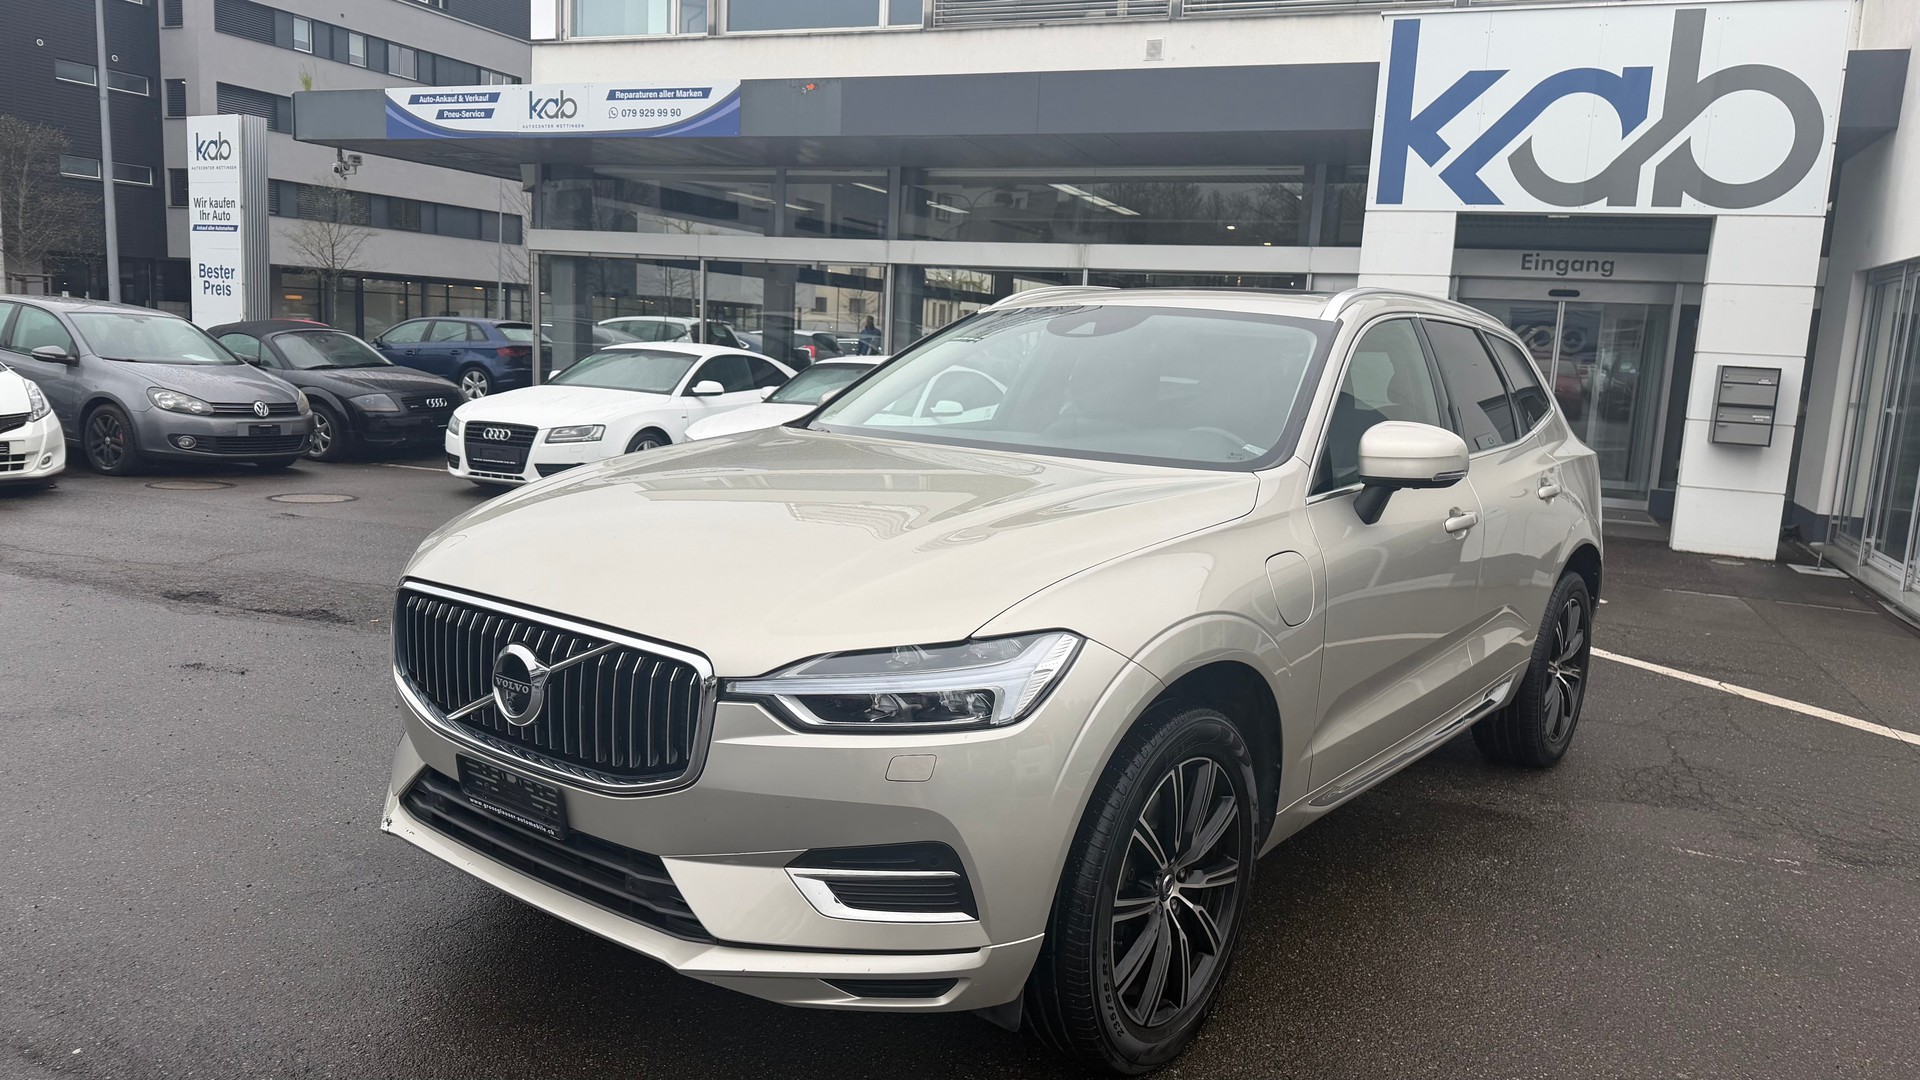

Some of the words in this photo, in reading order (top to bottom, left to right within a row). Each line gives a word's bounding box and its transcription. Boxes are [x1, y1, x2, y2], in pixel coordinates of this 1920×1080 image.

[419, 94, 458, 103] Auto-Ankauf
[458, 94, 464, 102] &
[465, 93, 489, 102] Verkauf
[615, 91, 658, 100] Reparaturen
[659, 90, 674, 98] aller
[676, 89, 703, 98] Marken
[528, 89, 578, 119] kab
[621, 108, 637, 117] 079
[639, 108, 655, 117] 929
[657, 108, 668, 117] 99
[670, 108, 681, 117] 90
[1376, 8, 1825, 209] kab
[443, 110, 485, 118] Pneu-Service
[195, 131, 232, 161] kab
[193, 197, 207, 209] Wir
[208, 197, 236, 209] kaufen
[199, 209, 210, 221] Ihr
[212, 209, 231, 221] Auto
[198, 263, 235, 280] Bester
[1521, 252, 1615, 277] Eingang
[203, 280, 232, 297] Preis
[495, 676, 529, 694] VOLVO
[1103, 982, 1125, 1037] 235/55
